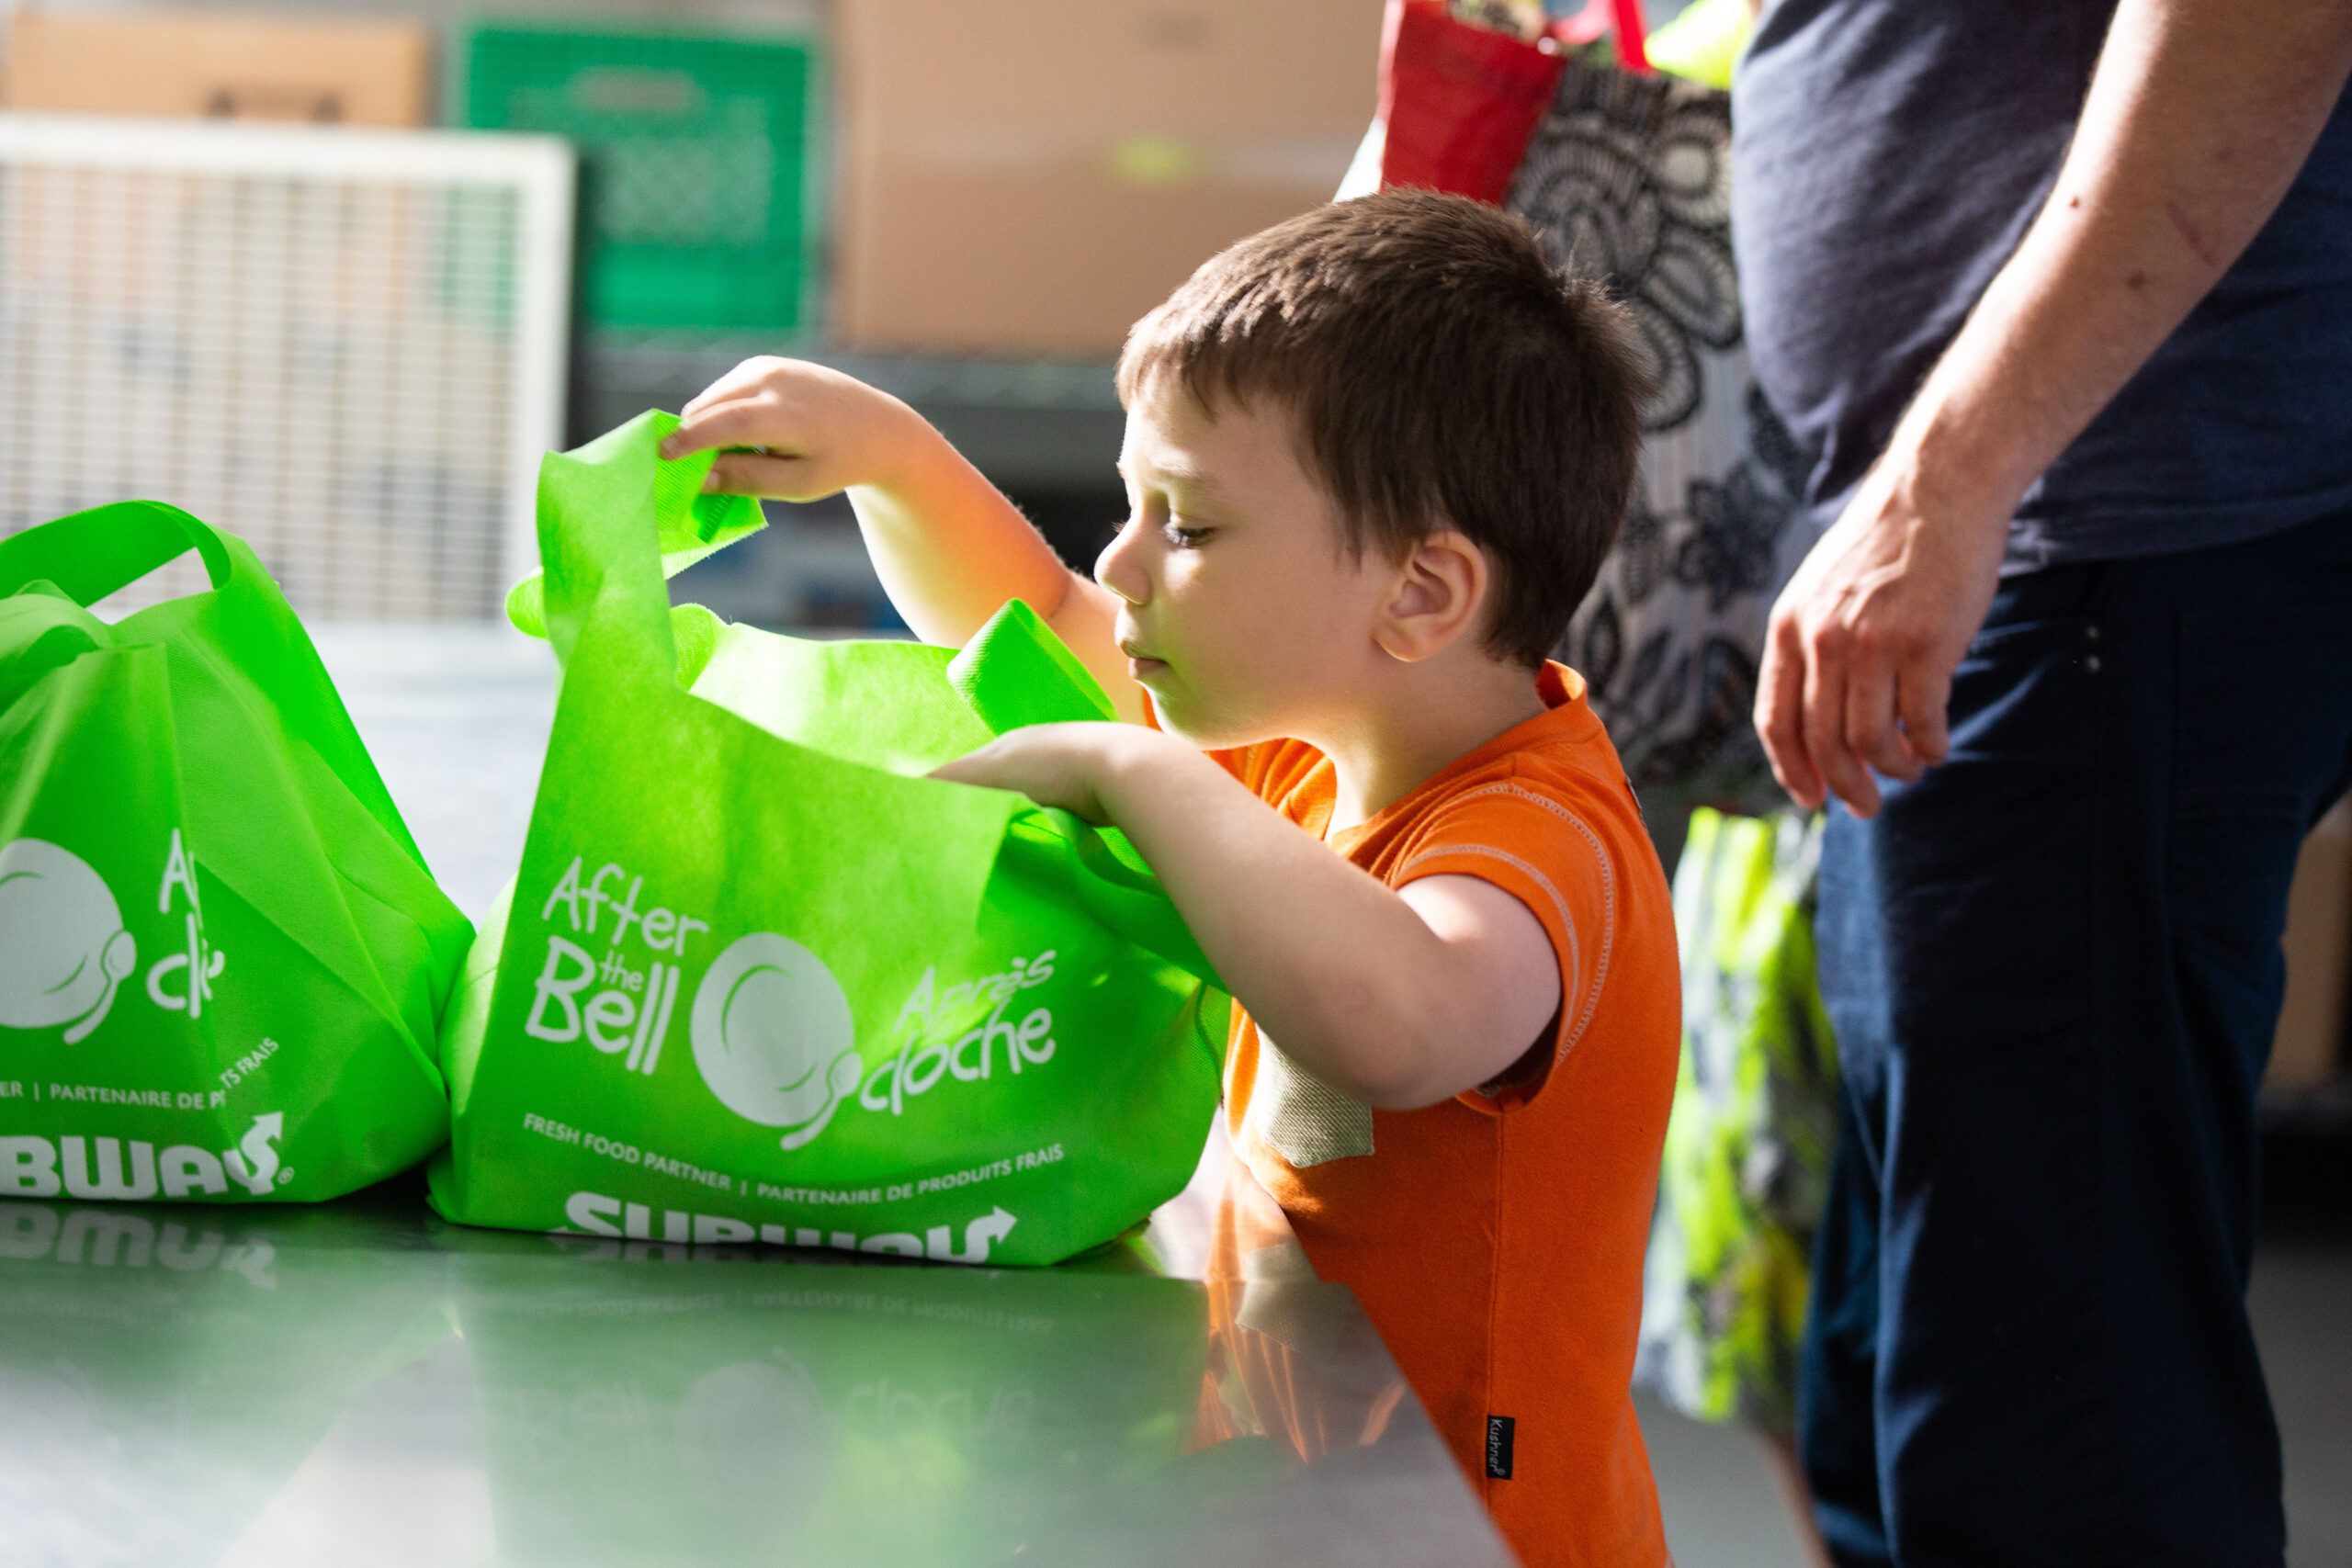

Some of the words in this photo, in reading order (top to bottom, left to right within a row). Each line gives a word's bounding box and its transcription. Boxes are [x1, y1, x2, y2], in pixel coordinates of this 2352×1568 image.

[542, 855, 709, 956] After
[525, 934, 681, 1076] Bell
[599, 949, 643, 992] the
[50, 1084, 172, 1108] PARTENAIRE
[177, 1092, 205, 1110] DE
[235, 1036, 279, 1076] FRAIS
[860, 997, 1056, 1116] cloche
[523, 1112, 580, 1145] FRESH
[583, 1132, 640, 1164] FOOD
[644, 1151, 730, 1190] PARTNER
[757, 1183, 881, 1205] PARTENAIRE
[887, 1182, 913, 1201] DE
[919, 1158, 1011, 1194] PRODUITS
[1015, 1143, 1064, 1171] FRAIS
